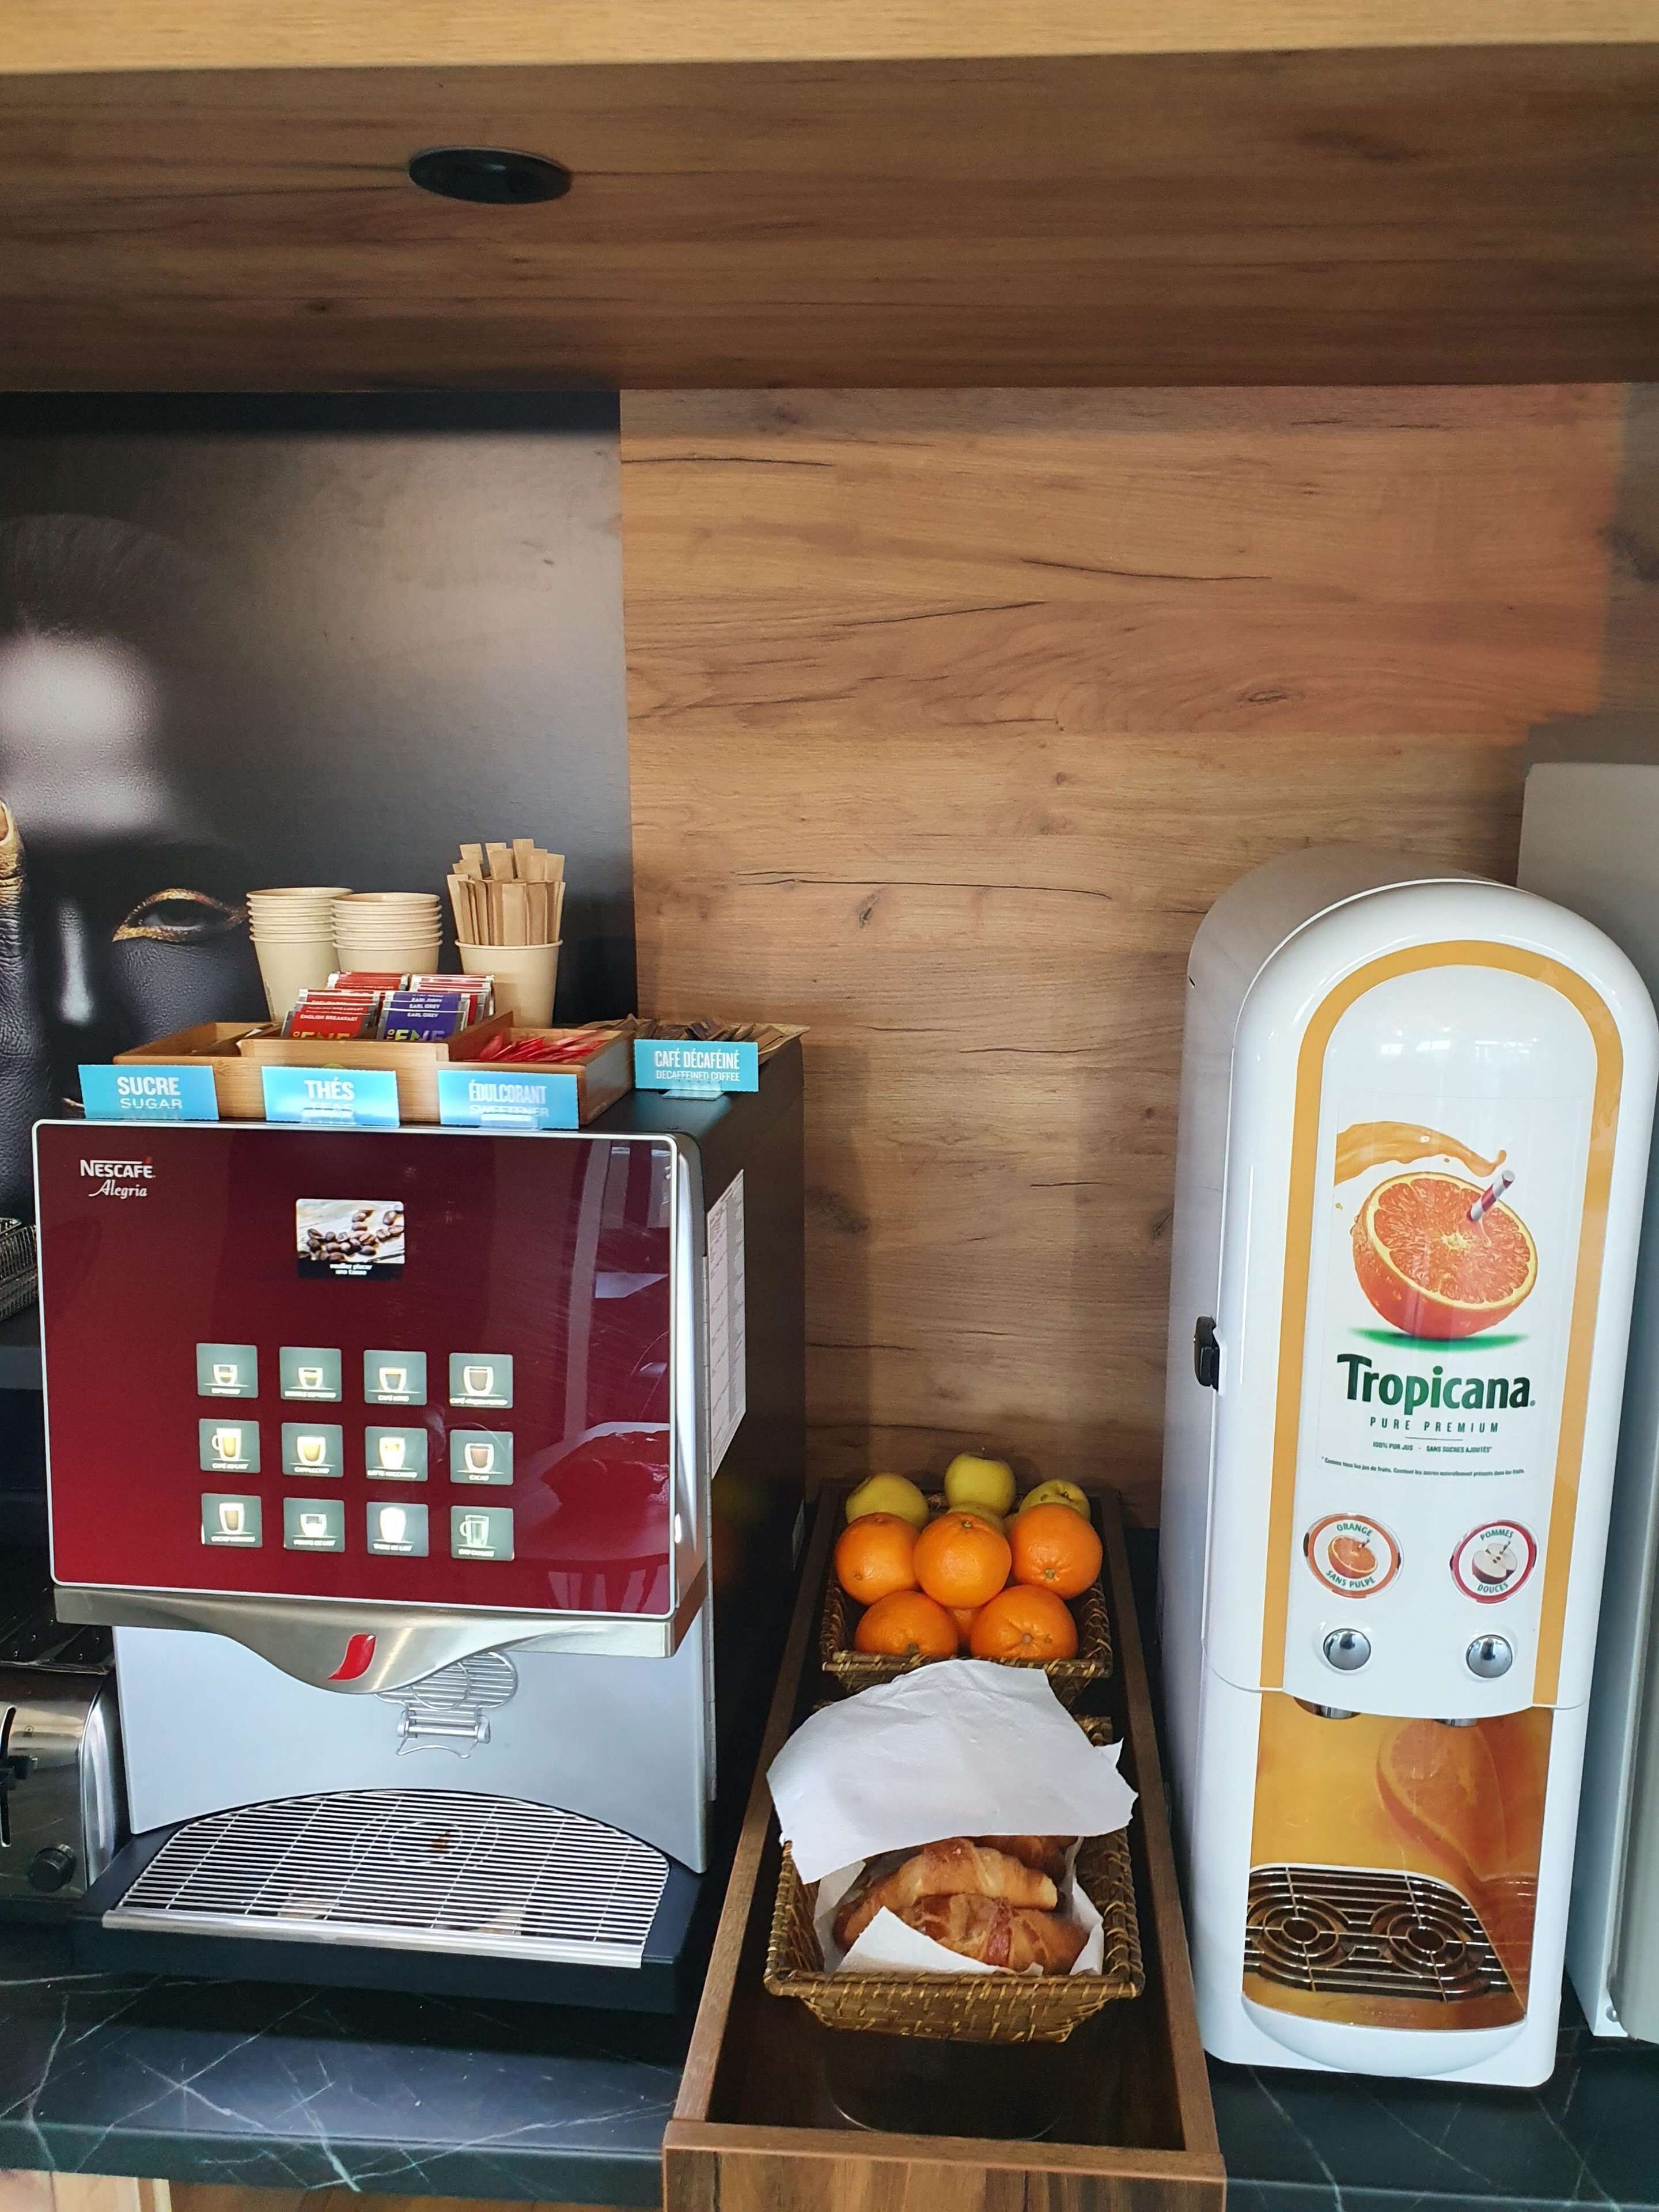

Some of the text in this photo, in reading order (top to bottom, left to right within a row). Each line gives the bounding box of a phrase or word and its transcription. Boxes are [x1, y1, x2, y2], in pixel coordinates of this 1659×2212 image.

[655, 1048, 740, 1070] CAFÉ DÉCAFÉINÉ
[656, 1070, 741, 1081] DECAFFEINED COFFEE
[117, 1076, 181, 1096] SUCRE
[304, 1076, 355, 1101] THÉS
[468, 1078, 547, 1104] ÉDULCORANT
[120, 1098, 183, 1109] SUGAR
[80, 1156, 153, 1179] NESCAFÉ
[88, 1179, 147, 1199] Alegria
[1337, 1353, 1531, 1415] Tropicana
[1370, 1416, 1498, 1433] PURE PREMIUM
[1336, 1522, 1373, 1537] ORANGE
[1480, 1528, 1514, 1541] POMMES
[1326, 1570, 1376, 1588] SANS PULPE
[1477, 1582, 1509, 1593] DOUCES
